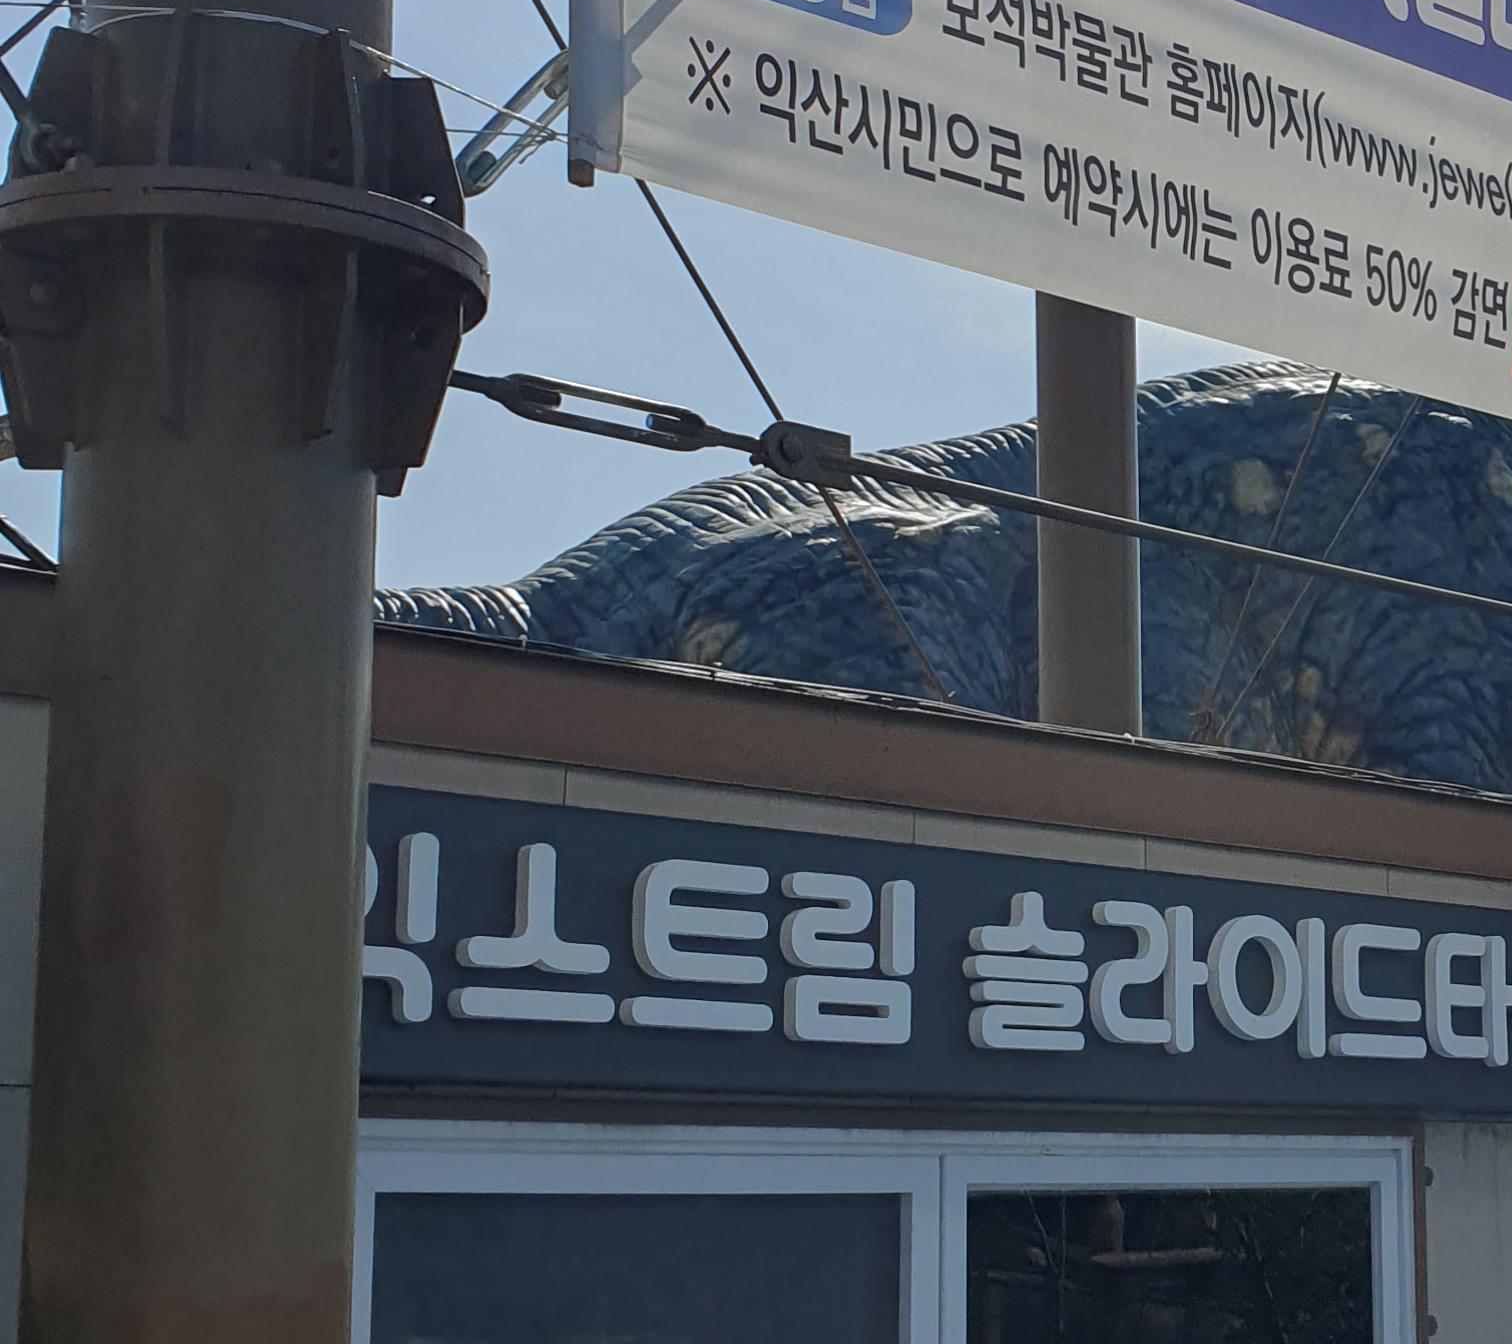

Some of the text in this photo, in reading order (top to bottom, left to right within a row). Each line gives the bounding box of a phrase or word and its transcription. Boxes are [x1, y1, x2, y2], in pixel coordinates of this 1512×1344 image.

[755, 53, 1025, 201] 익산시민으로
[1043, 143, 1237, 269] 예약시에는
[1251, 208, 1353, 298] 이용료
[1366, 244, 1438, 321] 50%
[1451, 269, 1509, 349] 감면
